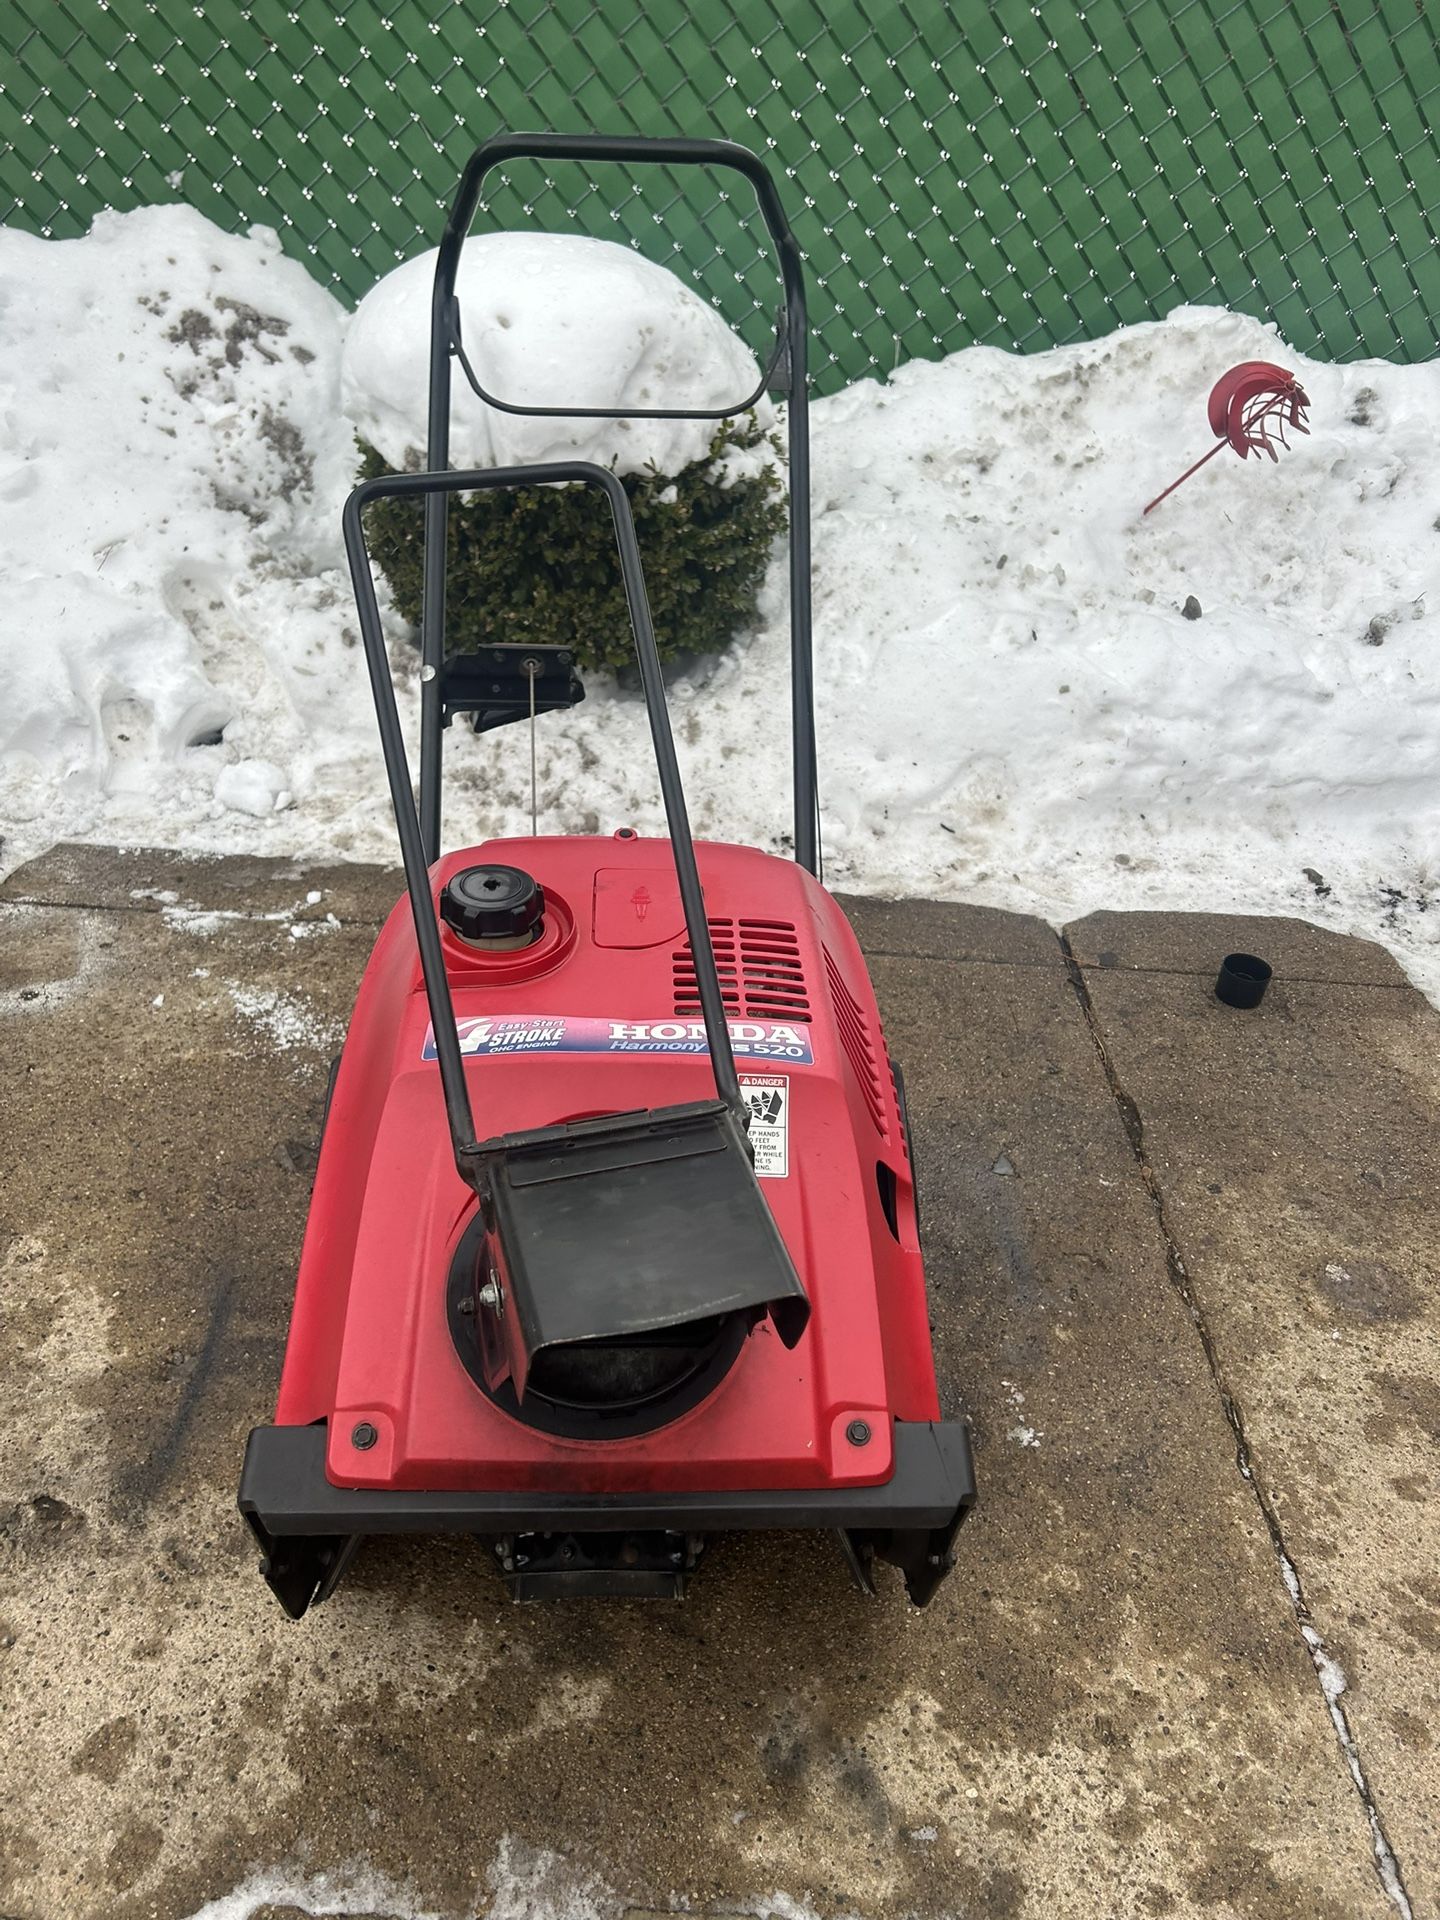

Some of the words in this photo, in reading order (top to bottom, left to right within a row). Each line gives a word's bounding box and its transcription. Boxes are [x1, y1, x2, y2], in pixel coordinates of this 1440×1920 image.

[489, 1028, 567, 1047] STROKE
[489, 1045, 513, 1053] OHC
[516, 1041, 559, 1050] ENGINE
[610, 1041, 706, 1052] Harmony
[732, 1043, 751, 1053] S
[754, 1043, 804, 1057] 520
[752, 1078, 784, 1087] DANGER
